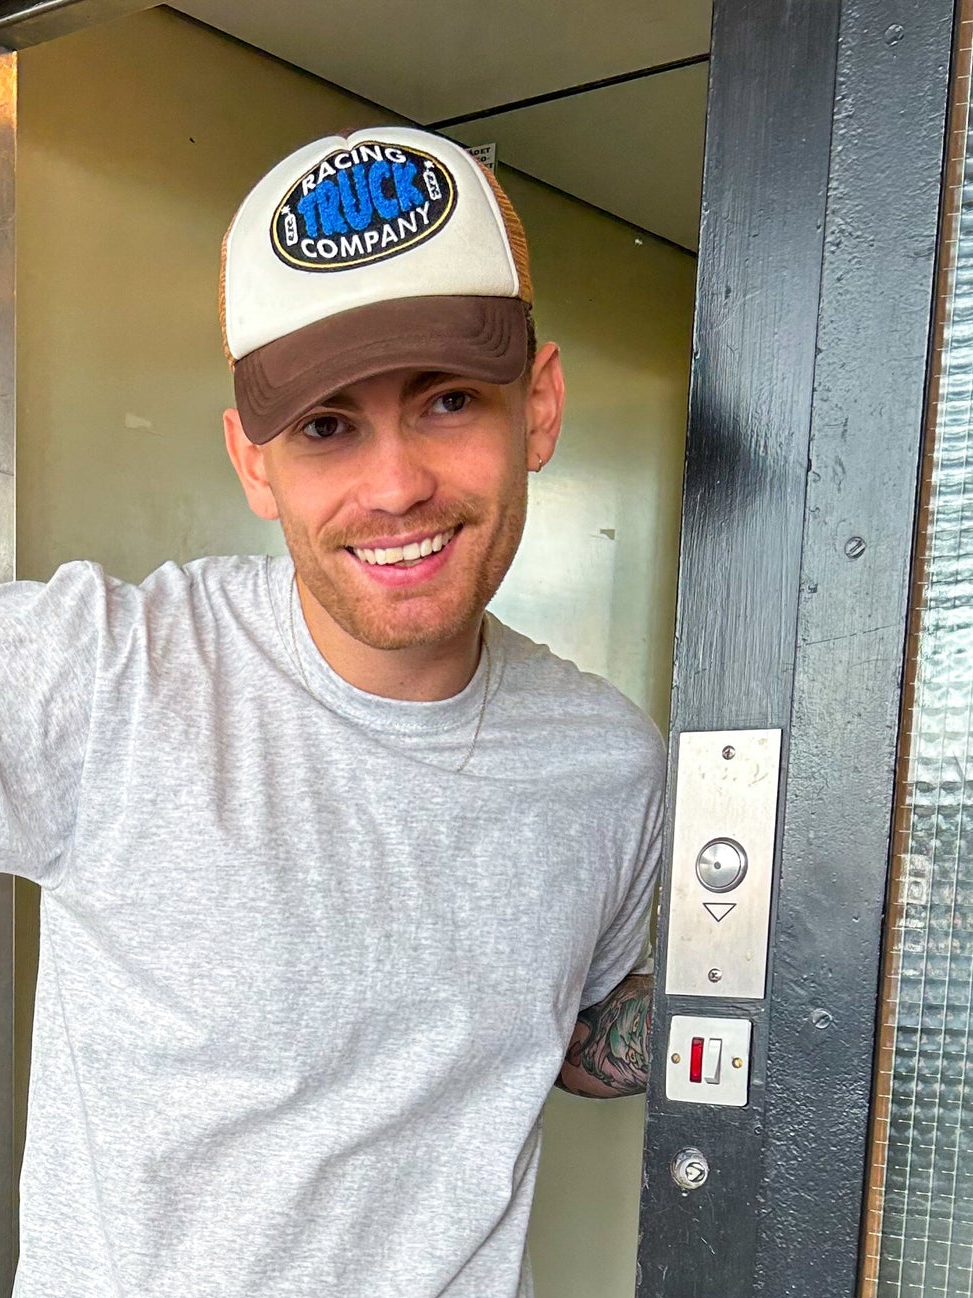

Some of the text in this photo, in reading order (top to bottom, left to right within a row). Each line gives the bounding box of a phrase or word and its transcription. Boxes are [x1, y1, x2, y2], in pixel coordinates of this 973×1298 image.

[297, 160, 424, 238] TRUCK
[302, 146, 407, 196] RACING
[300, 201, 430, 259] COMPANY
